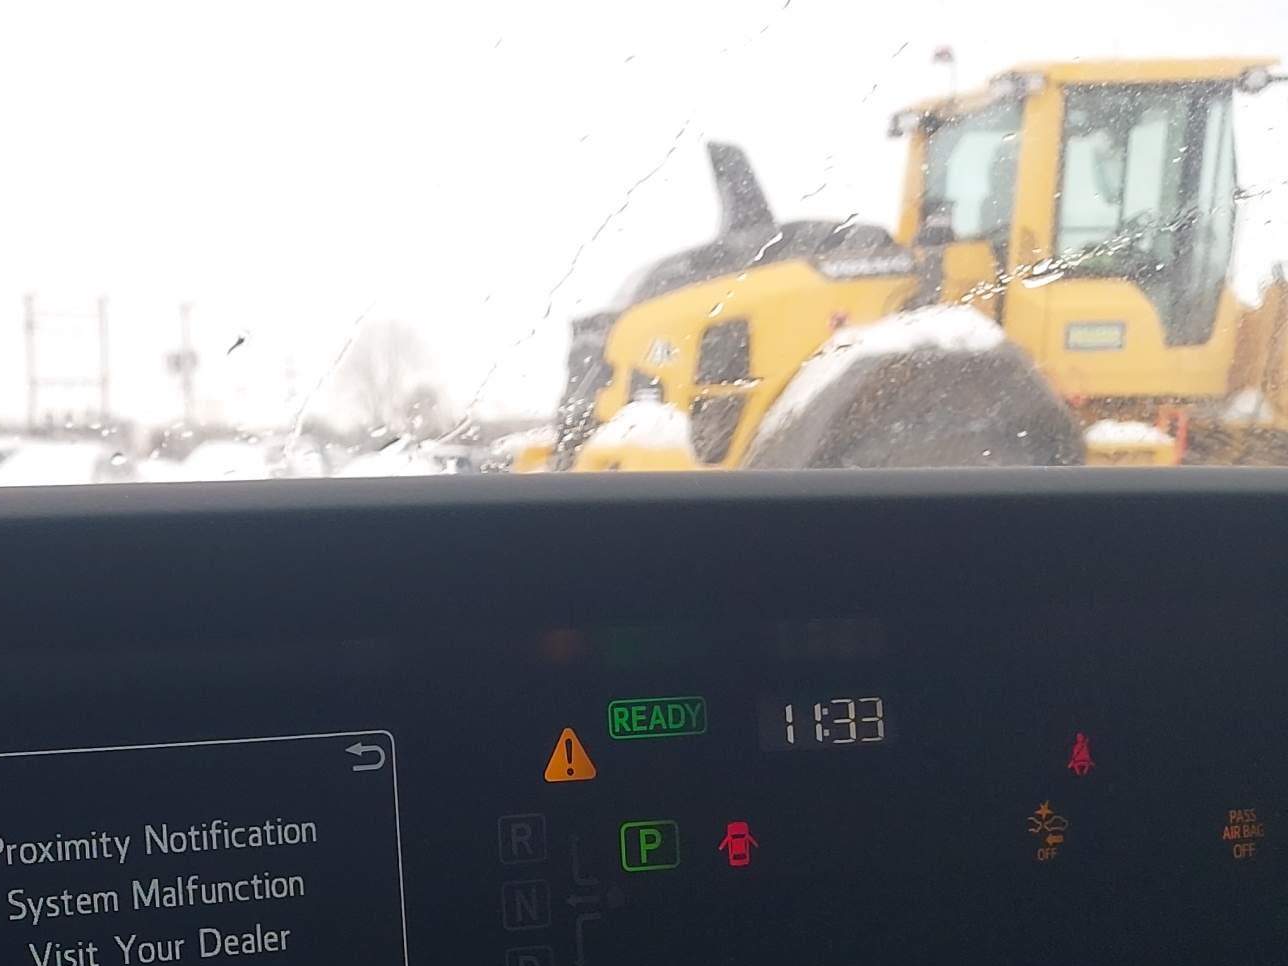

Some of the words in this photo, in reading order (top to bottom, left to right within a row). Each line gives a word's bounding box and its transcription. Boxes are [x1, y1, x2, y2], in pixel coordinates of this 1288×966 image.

[614, 703, 701, 732] READY
[785, 697, 884, 744] 11:33
[1229, 808, 1256, 824] PASS
[145, 818, 317, 855] Notification
[510, 821, 534, 857] R
[638, 827, 662, 865] P
[1037, 847, 1058, 862] OFF
[1233, 843, 1257, 858] OFF
[8, 889, 119, 926] System
[133, 872, 304, 910] Malfunction
[513, 888, 538, 924] N
[115, 934, 185, 965] Your
[200, 923, 291, 957] Dealer
